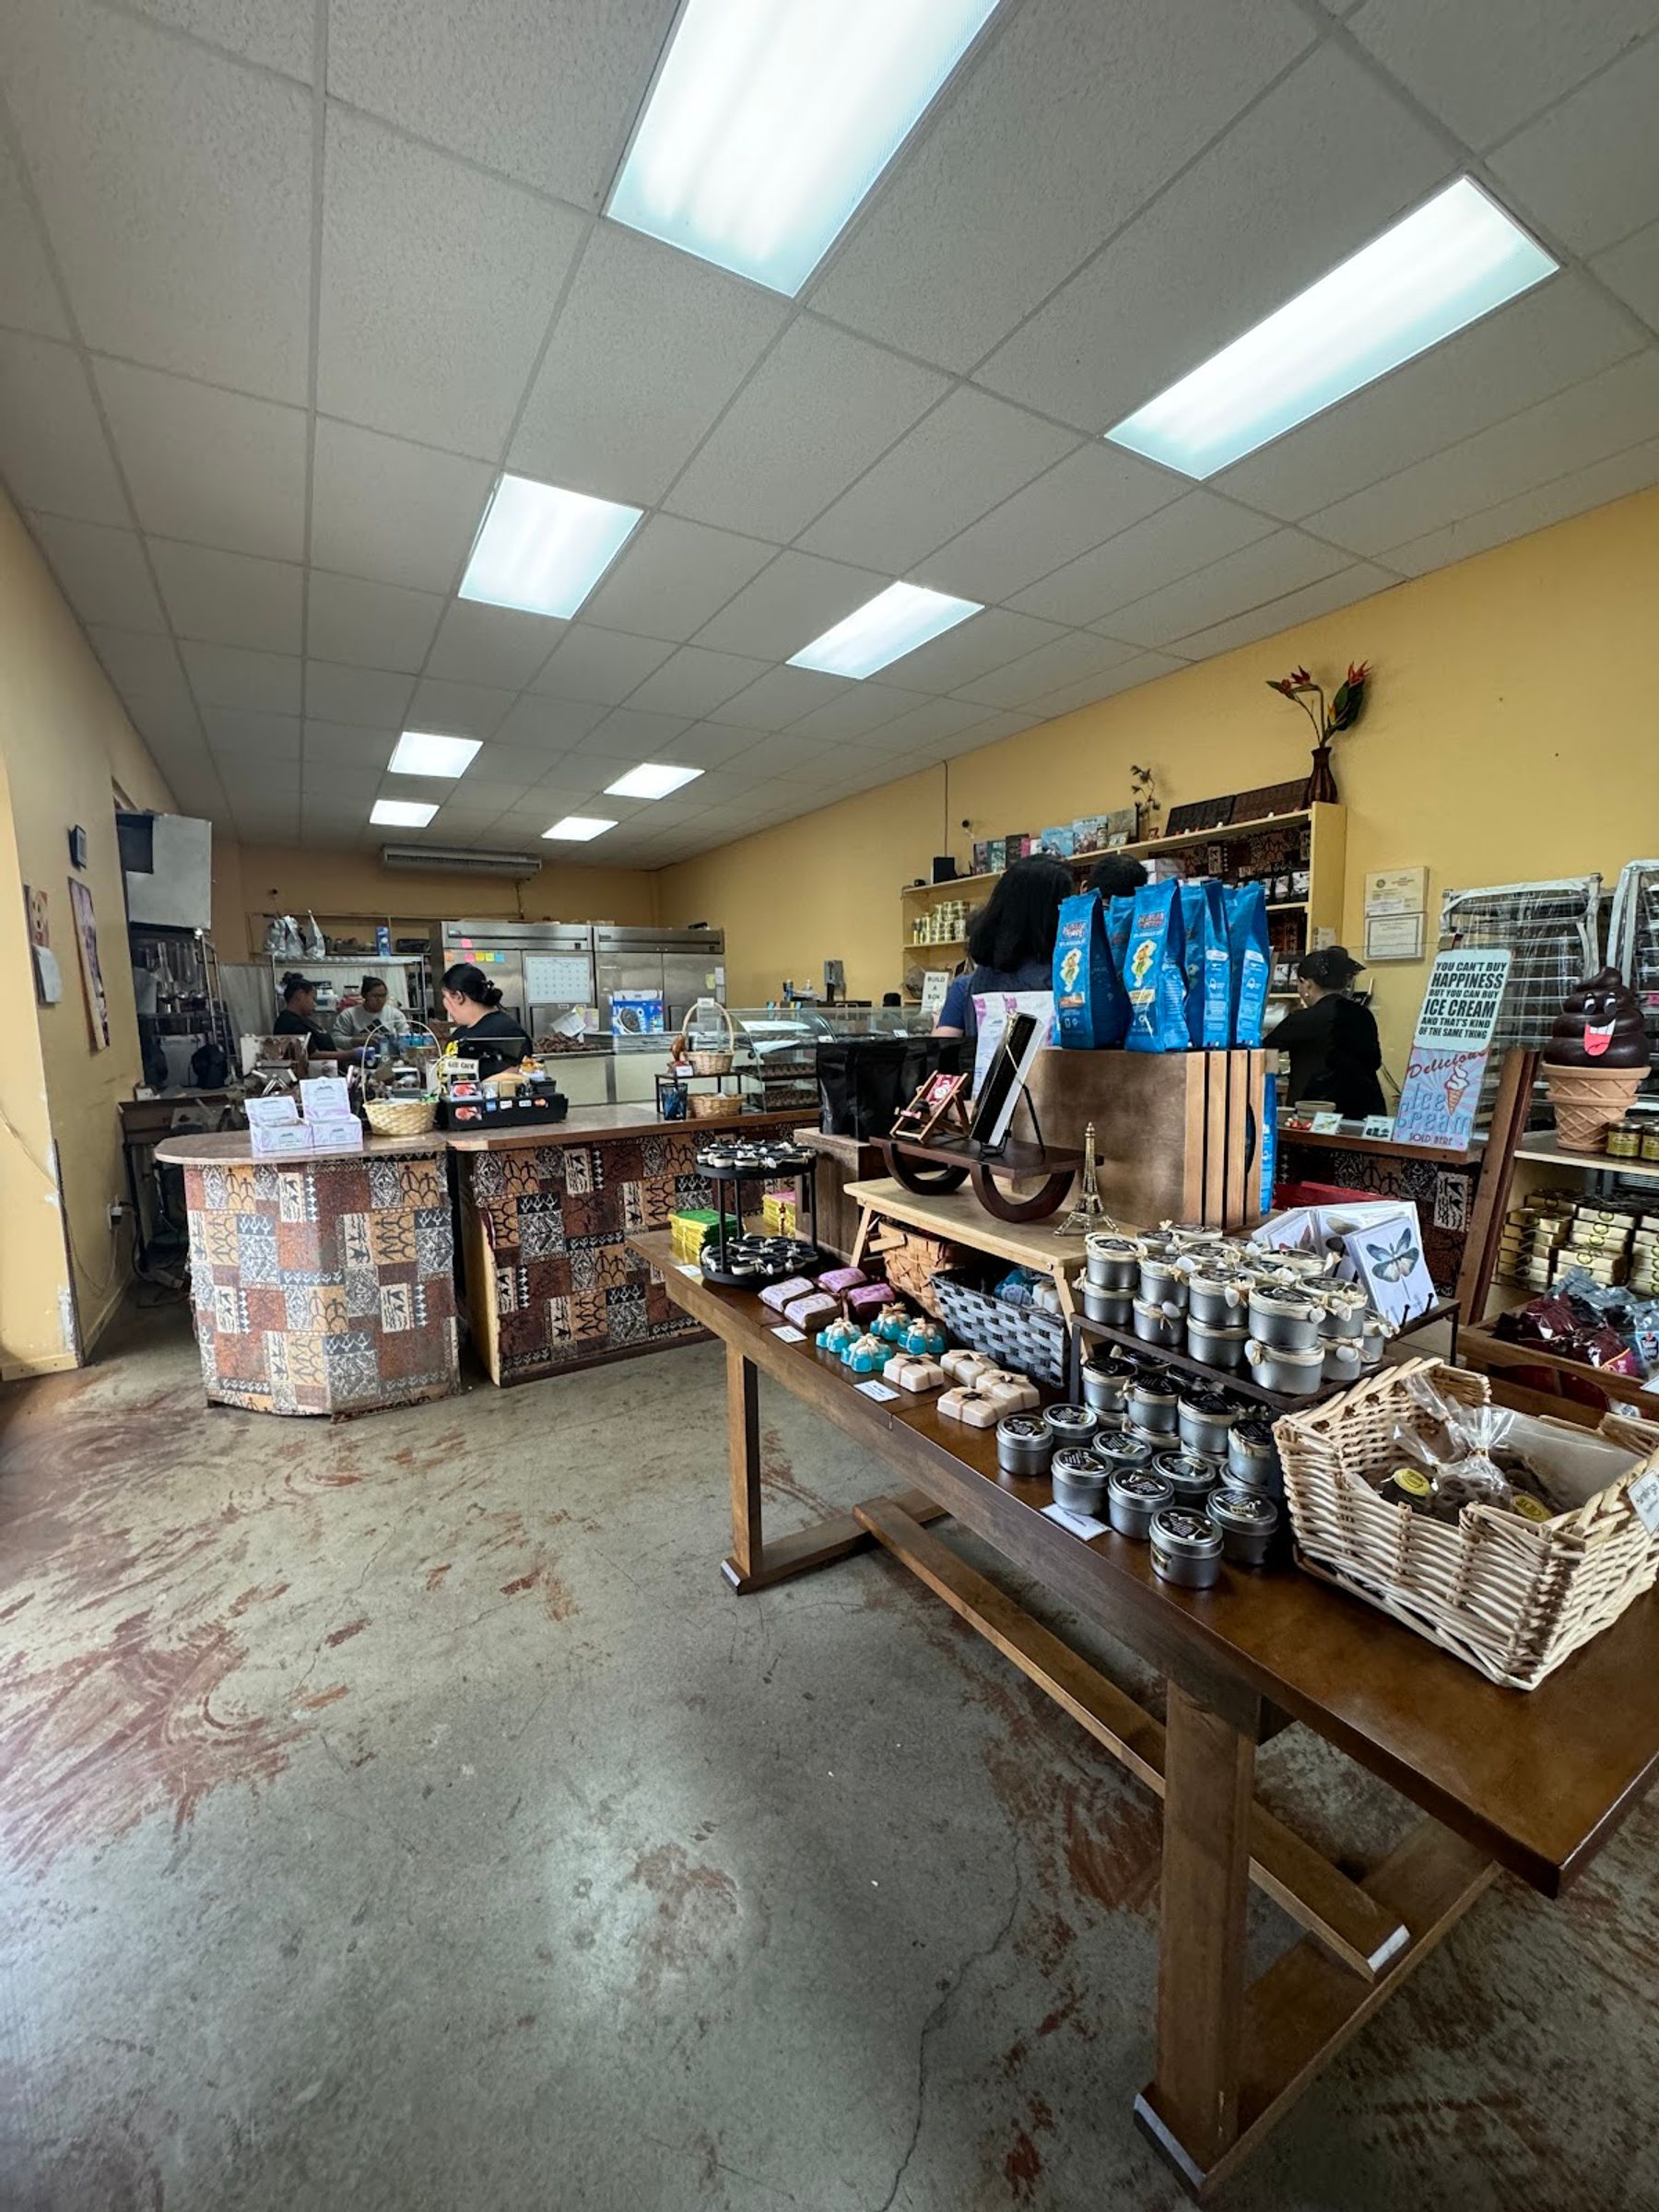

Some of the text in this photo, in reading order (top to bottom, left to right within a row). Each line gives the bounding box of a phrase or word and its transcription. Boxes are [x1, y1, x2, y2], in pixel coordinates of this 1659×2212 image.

[1436, 961, 1507, 971] YOU CAN'T BUY
[1430, 972, 1503, 989] HAPPINESS
[1429, 988, 1500, 998] BUT YOU CAN BUY
[1423, 998, 1496, 1018] ICE CREAM
[1421, 1017, 1491, 1029] AND THAT'S KIND
[1418, 1027, 1488, 1040] OF THE SAME THING
[1409, 1083, 1445, 1112] Ice
[1408, 1132, 1453, 1146] SOLD HERE
